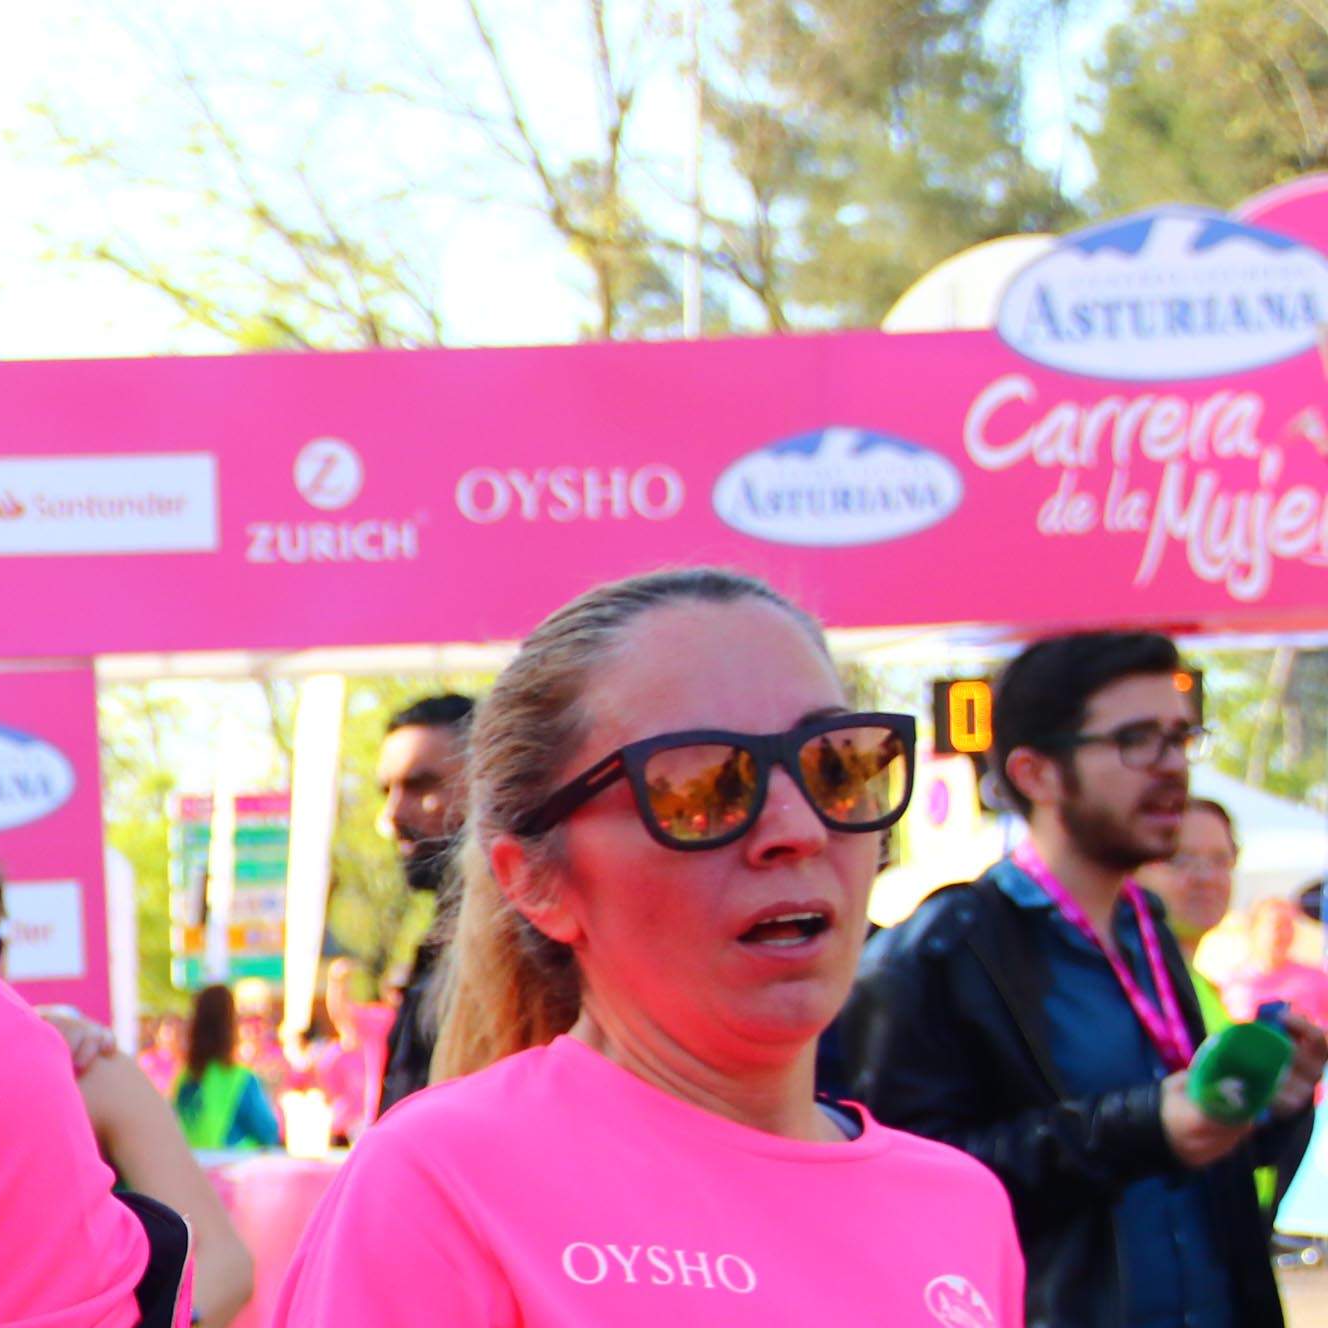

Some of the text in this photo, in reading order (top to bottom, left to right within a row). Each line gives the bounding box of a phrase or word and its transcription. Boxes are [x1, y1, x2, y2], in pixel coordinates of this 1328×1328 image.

[1024, 282, 1318, 342] ASTURIANA
[962, 373, 1263, 471] Carrera
[454, 463, 685, 524] OYSHO
[738, 475, 944, 520] ASTURIANA
[1036, 470, 1096, 534] de
[1103, 464, 1147, 532] la
[244, 521, 418, 564] ZURICH
[562, 1241, 757, 1293] OYSHO
